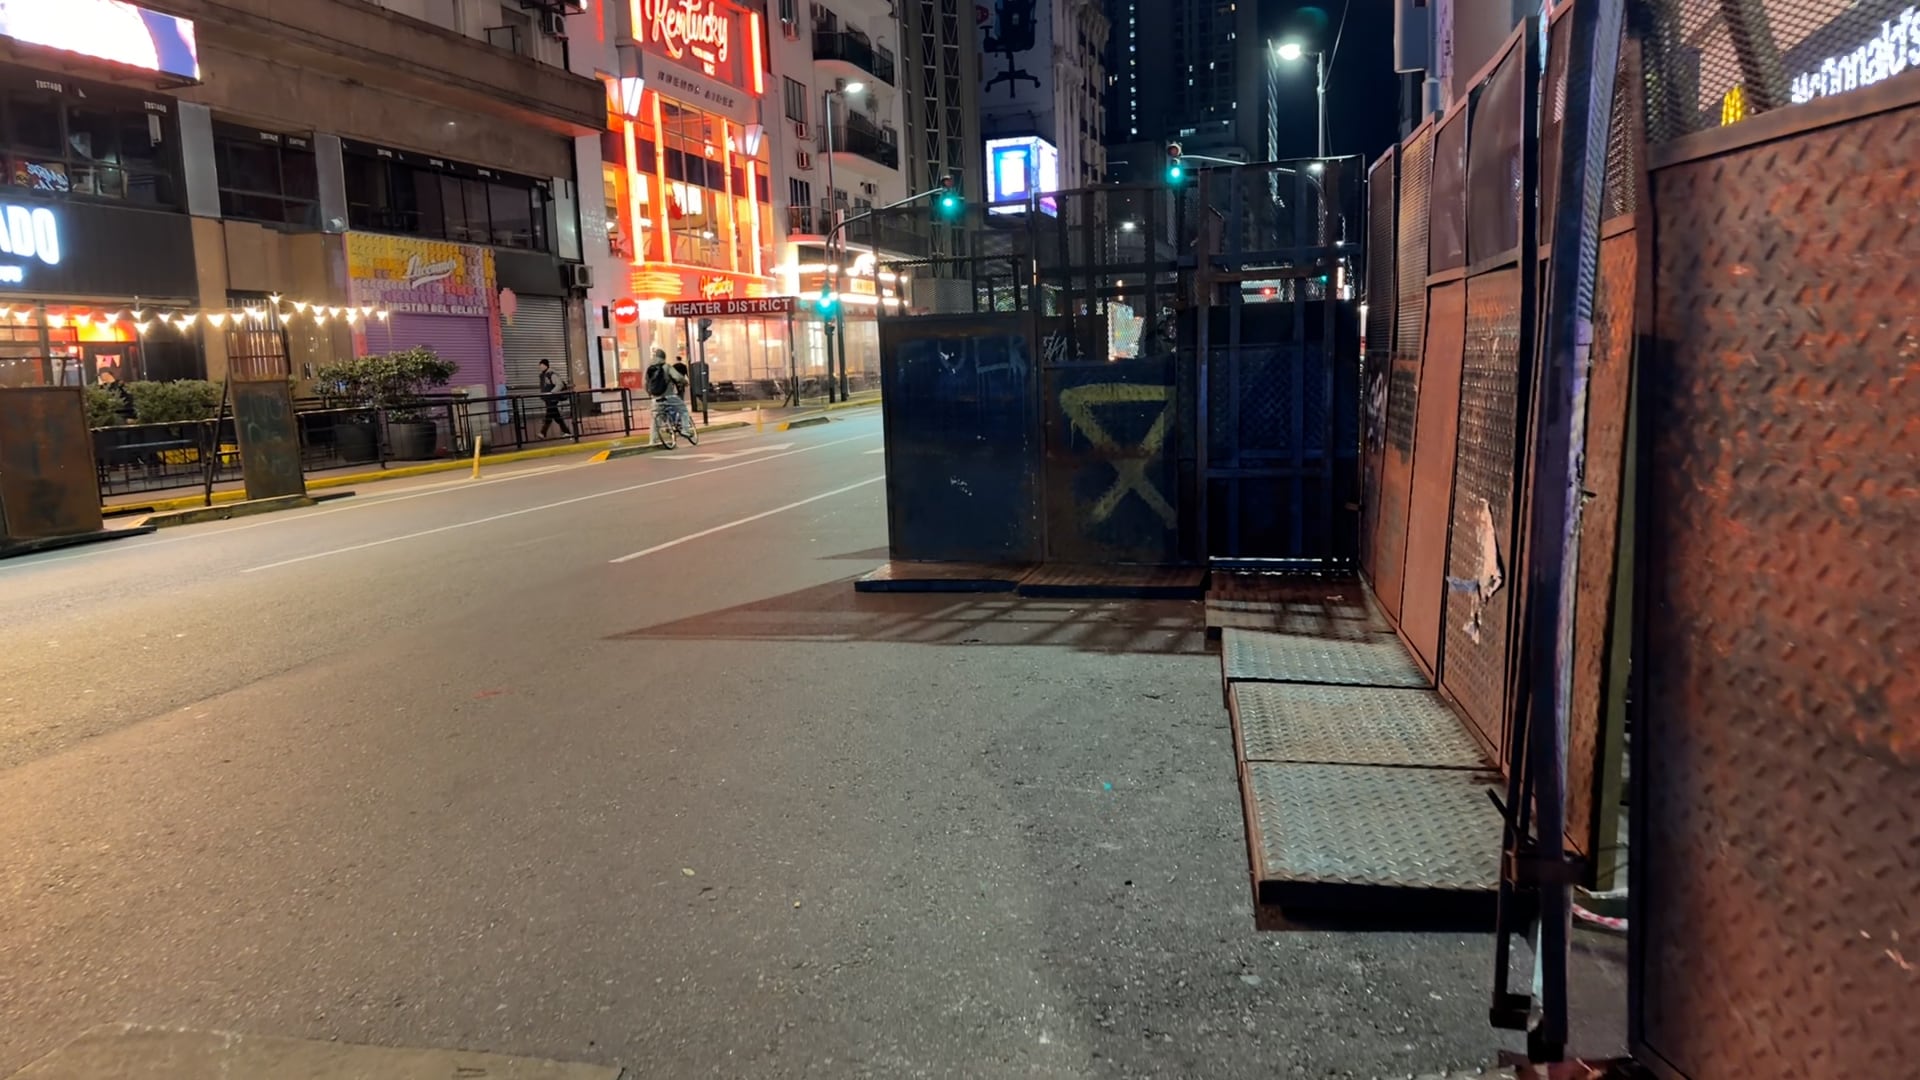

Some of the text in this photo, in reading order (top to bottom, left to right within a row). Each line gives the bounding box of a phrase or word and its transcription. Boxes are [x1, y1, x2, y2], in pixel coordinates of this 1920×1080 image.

[644, 0, 728, 62] Kentucky
[666, 298, 791, 316] THEATER DISTRICT
